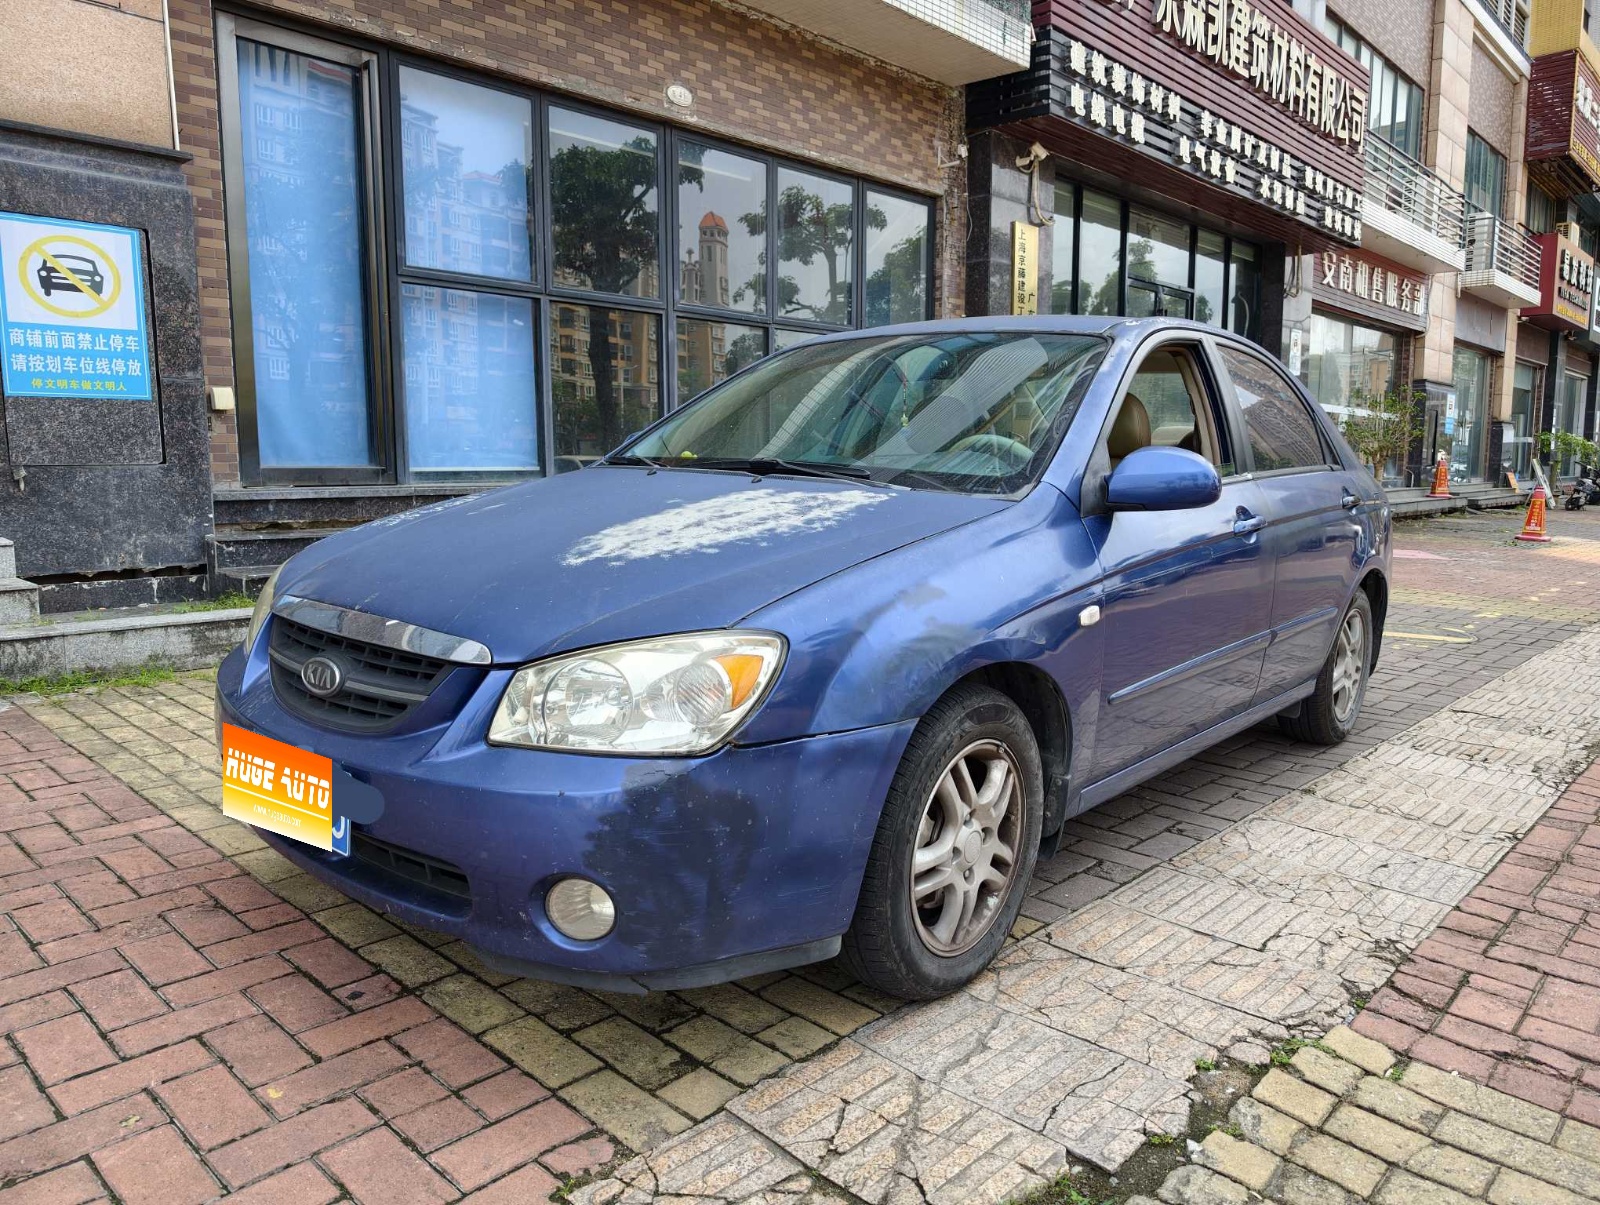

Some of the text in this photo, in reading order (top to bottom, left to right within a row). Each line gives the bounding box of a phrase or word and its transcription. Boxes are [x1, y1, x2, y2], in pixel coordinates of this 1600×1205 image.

[1179, 135, 1236, 184] 电气设备
[1322, 251, 1425, 317] 安南租售服务部
[8, 327, 140, 352] 商铺前面禁止停车
[10, 353, 142, 377] 请按划车位线停放
[31, 377, 127, 391] 停文明车做文明人
[306, 663, 331, 689] KIA
